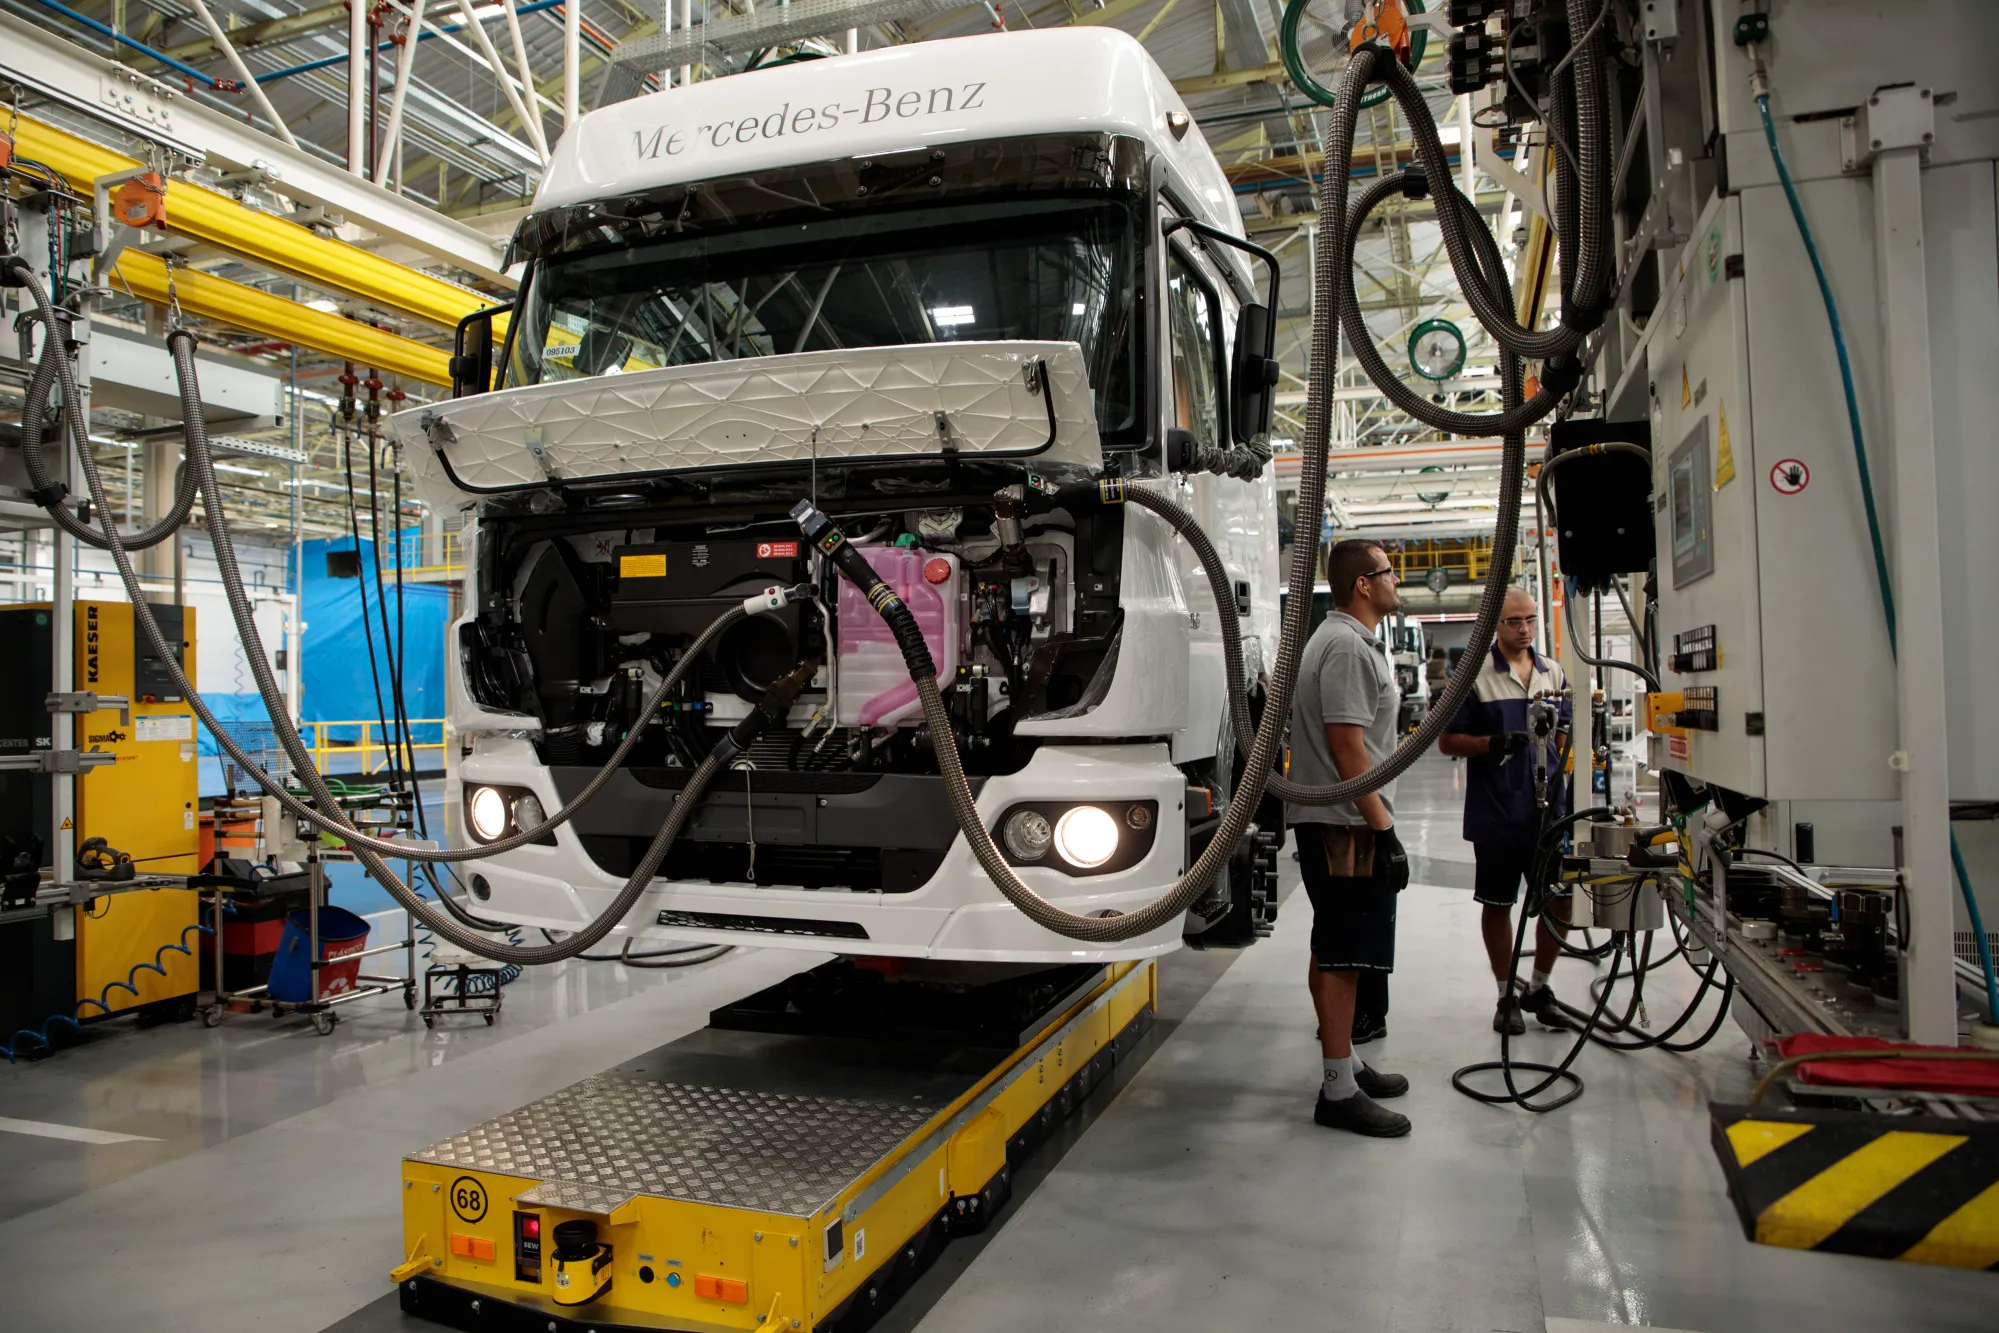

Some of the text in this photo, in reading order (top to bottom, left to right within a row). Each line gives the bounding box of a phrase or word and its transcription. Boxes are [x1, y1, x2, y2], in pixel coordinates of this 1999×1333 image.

[633, 81, 987, 160] Mercedes-Benz
[546, 346, 576, 356] 095103
[87, 605, 98, 683] KAESER
[35, 737, 51, 746] SK
[457, 1188, 481, 1211] 68
[523, 1241, 539, 1250] SEW
